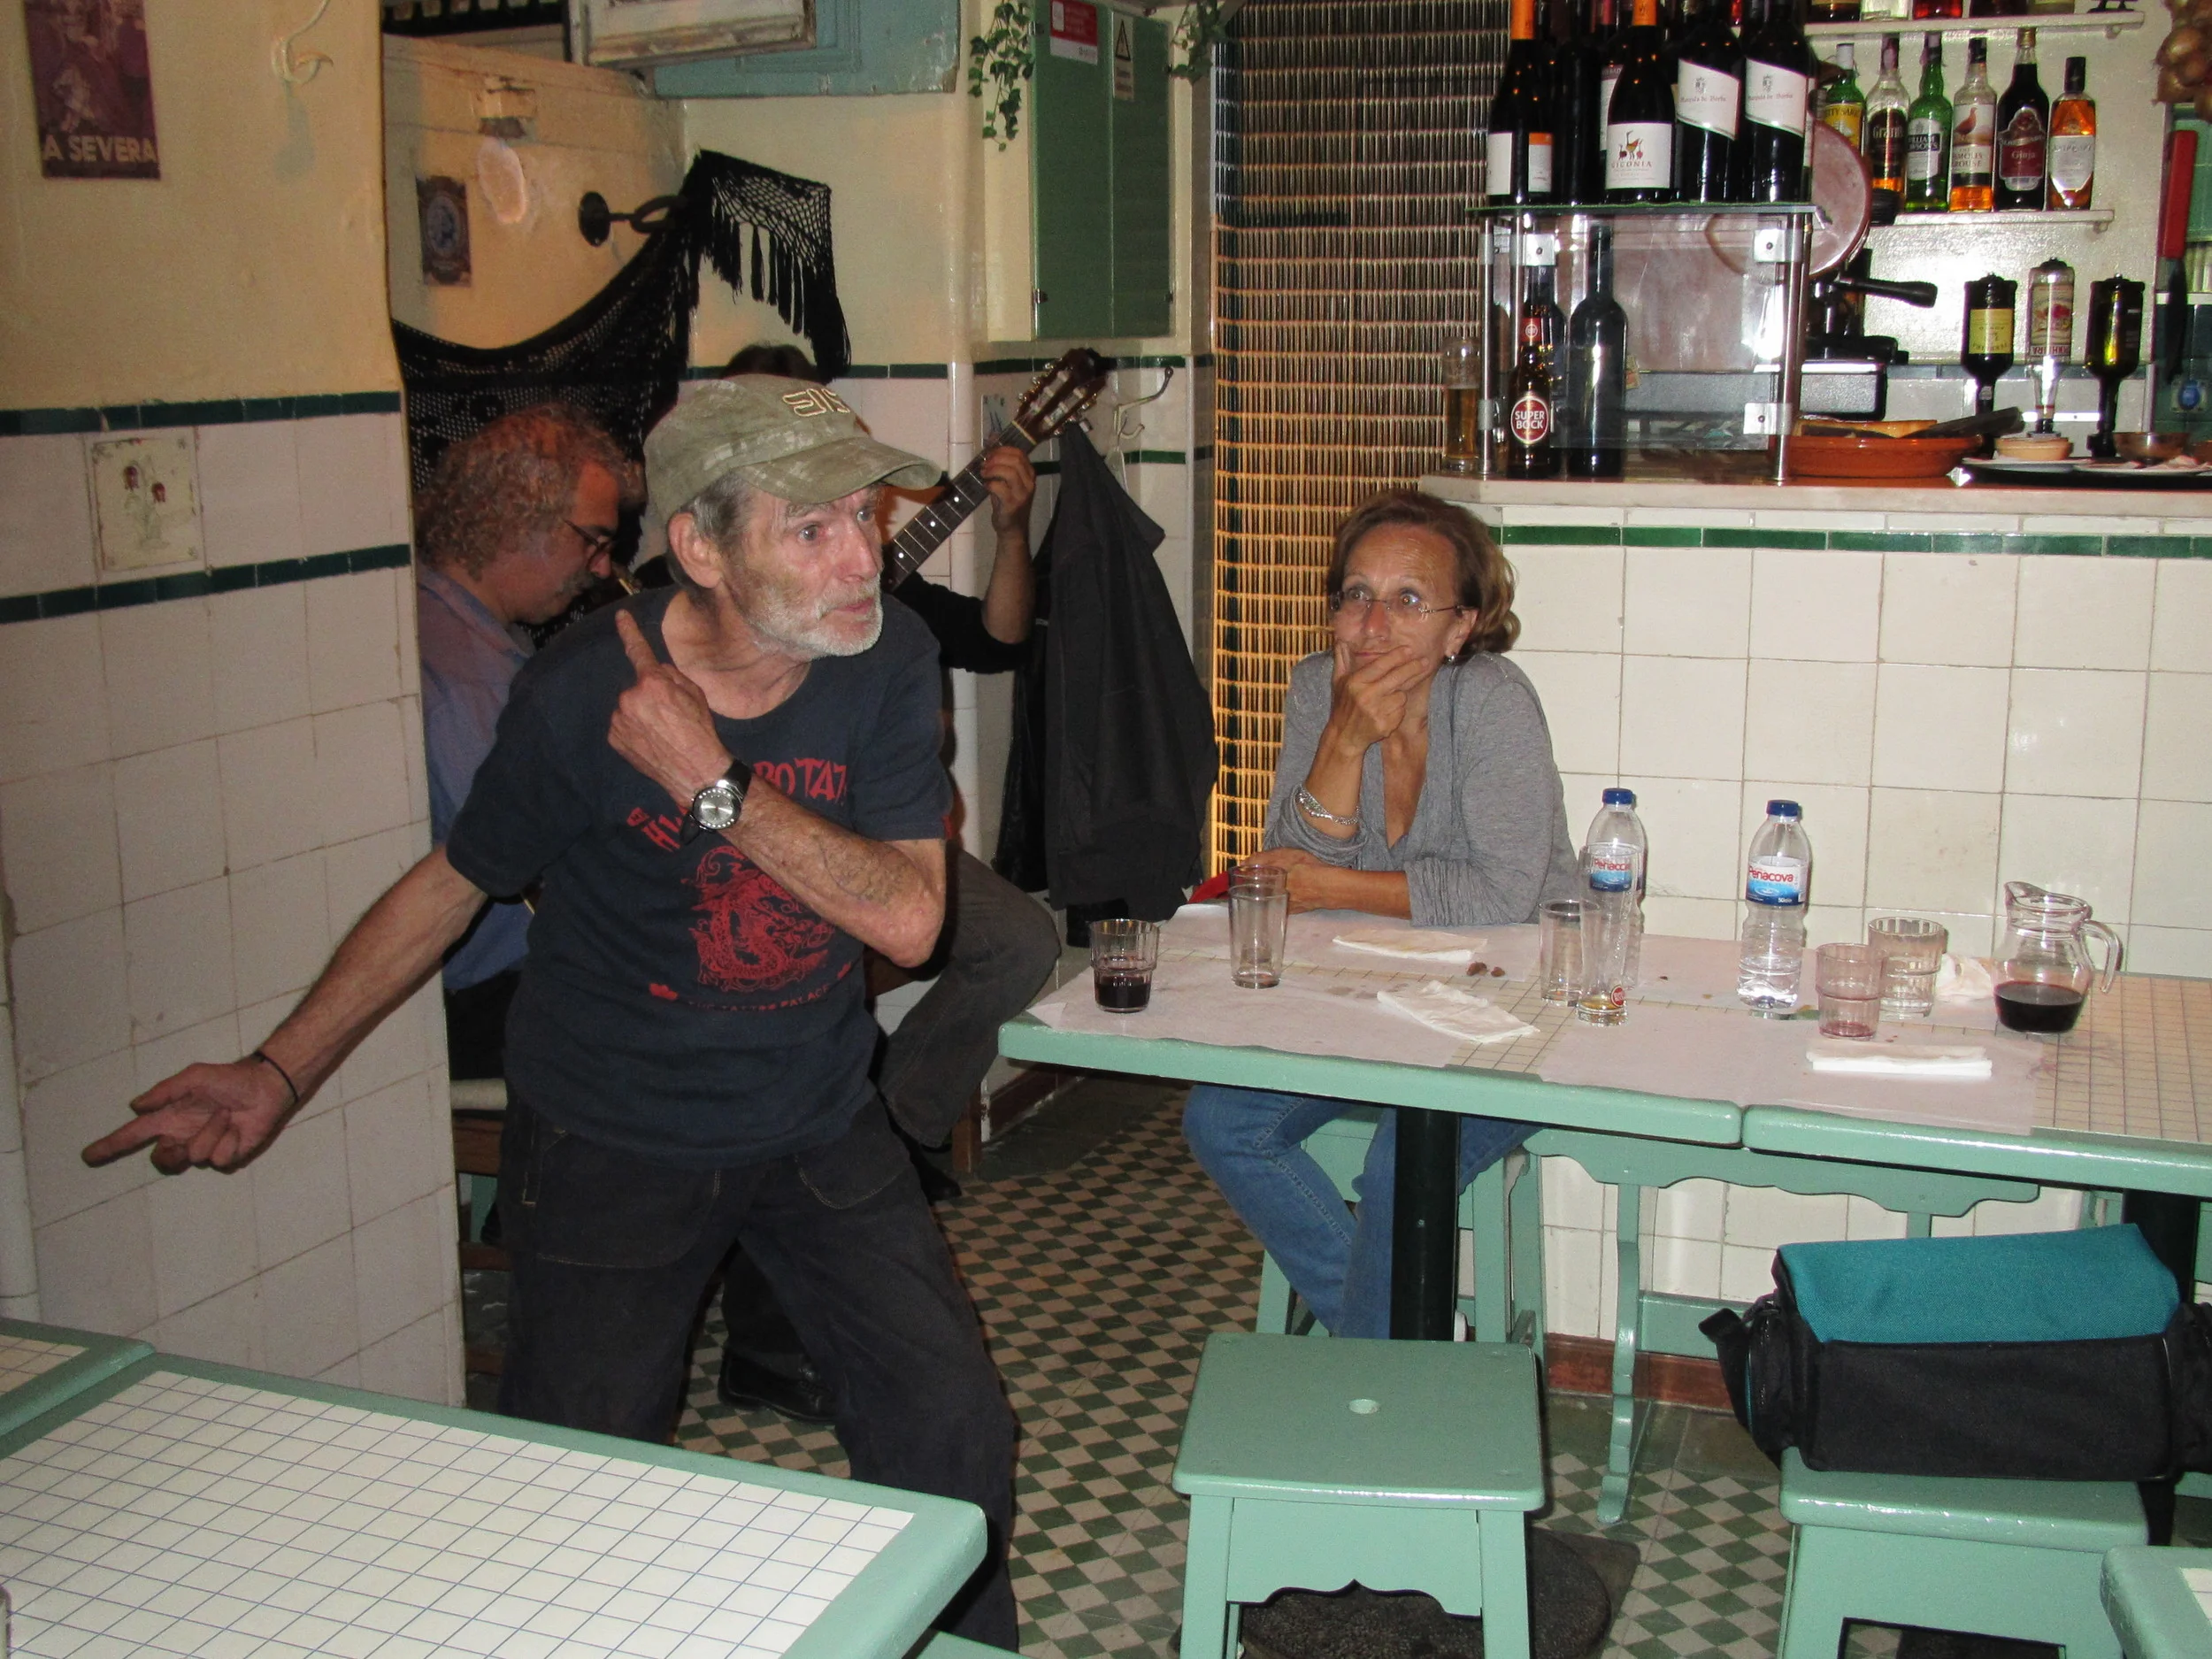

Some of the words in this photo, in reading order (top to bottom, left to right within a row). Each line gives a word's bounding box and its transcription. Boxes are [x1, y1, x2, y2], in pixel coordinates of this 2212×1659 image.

[44, 134, 65, 161] A
[68, 135, 157, 163] SEVERA
[1514, 411, 1545, 420] SUPER
[1516, 420, 1544, 430] BOCK
[1748, 864, 1794, 882] Penacova
